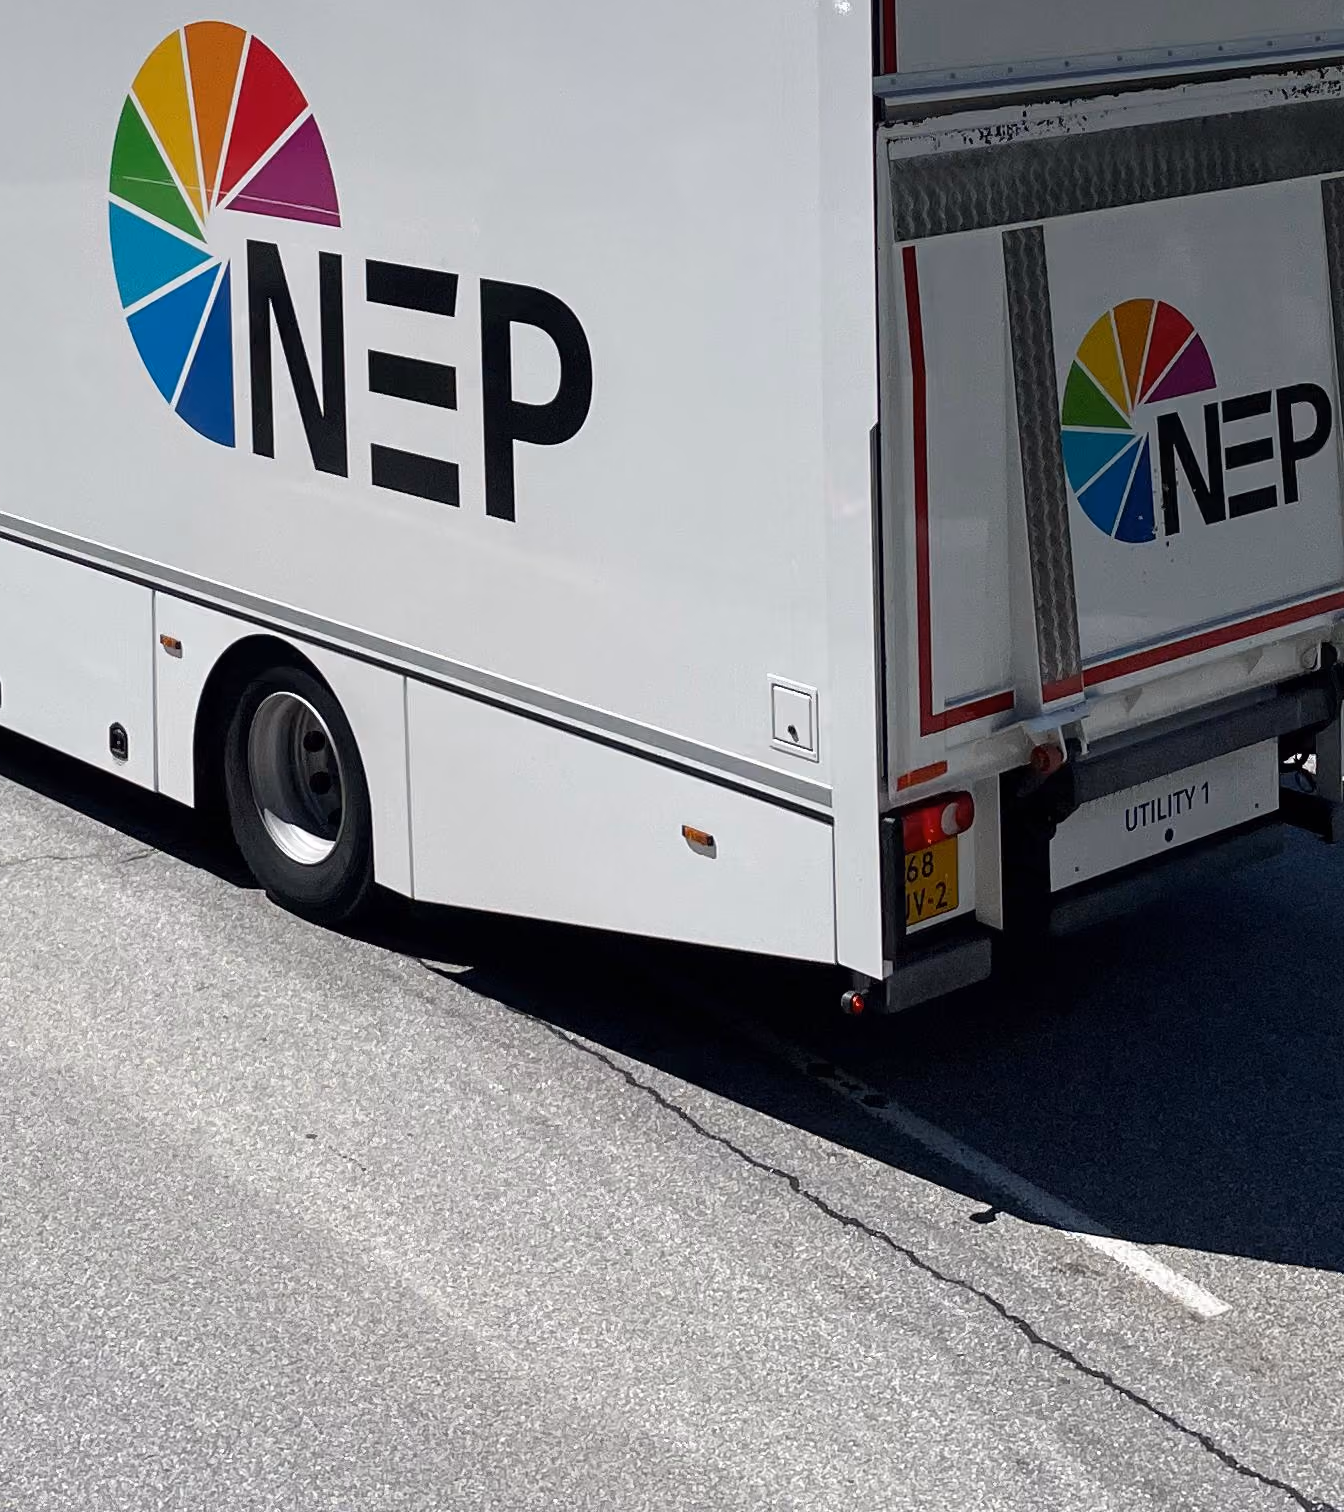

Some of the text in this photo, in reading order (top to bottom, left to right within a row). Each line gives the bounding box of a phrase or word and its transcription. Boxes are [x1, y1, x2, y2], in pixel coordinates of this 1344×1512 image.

[246, 238, 594, 523] NEP
[1157, 382, 1333, 537] NEP
[1125, 781, 1209, 832] UTILITY 1
